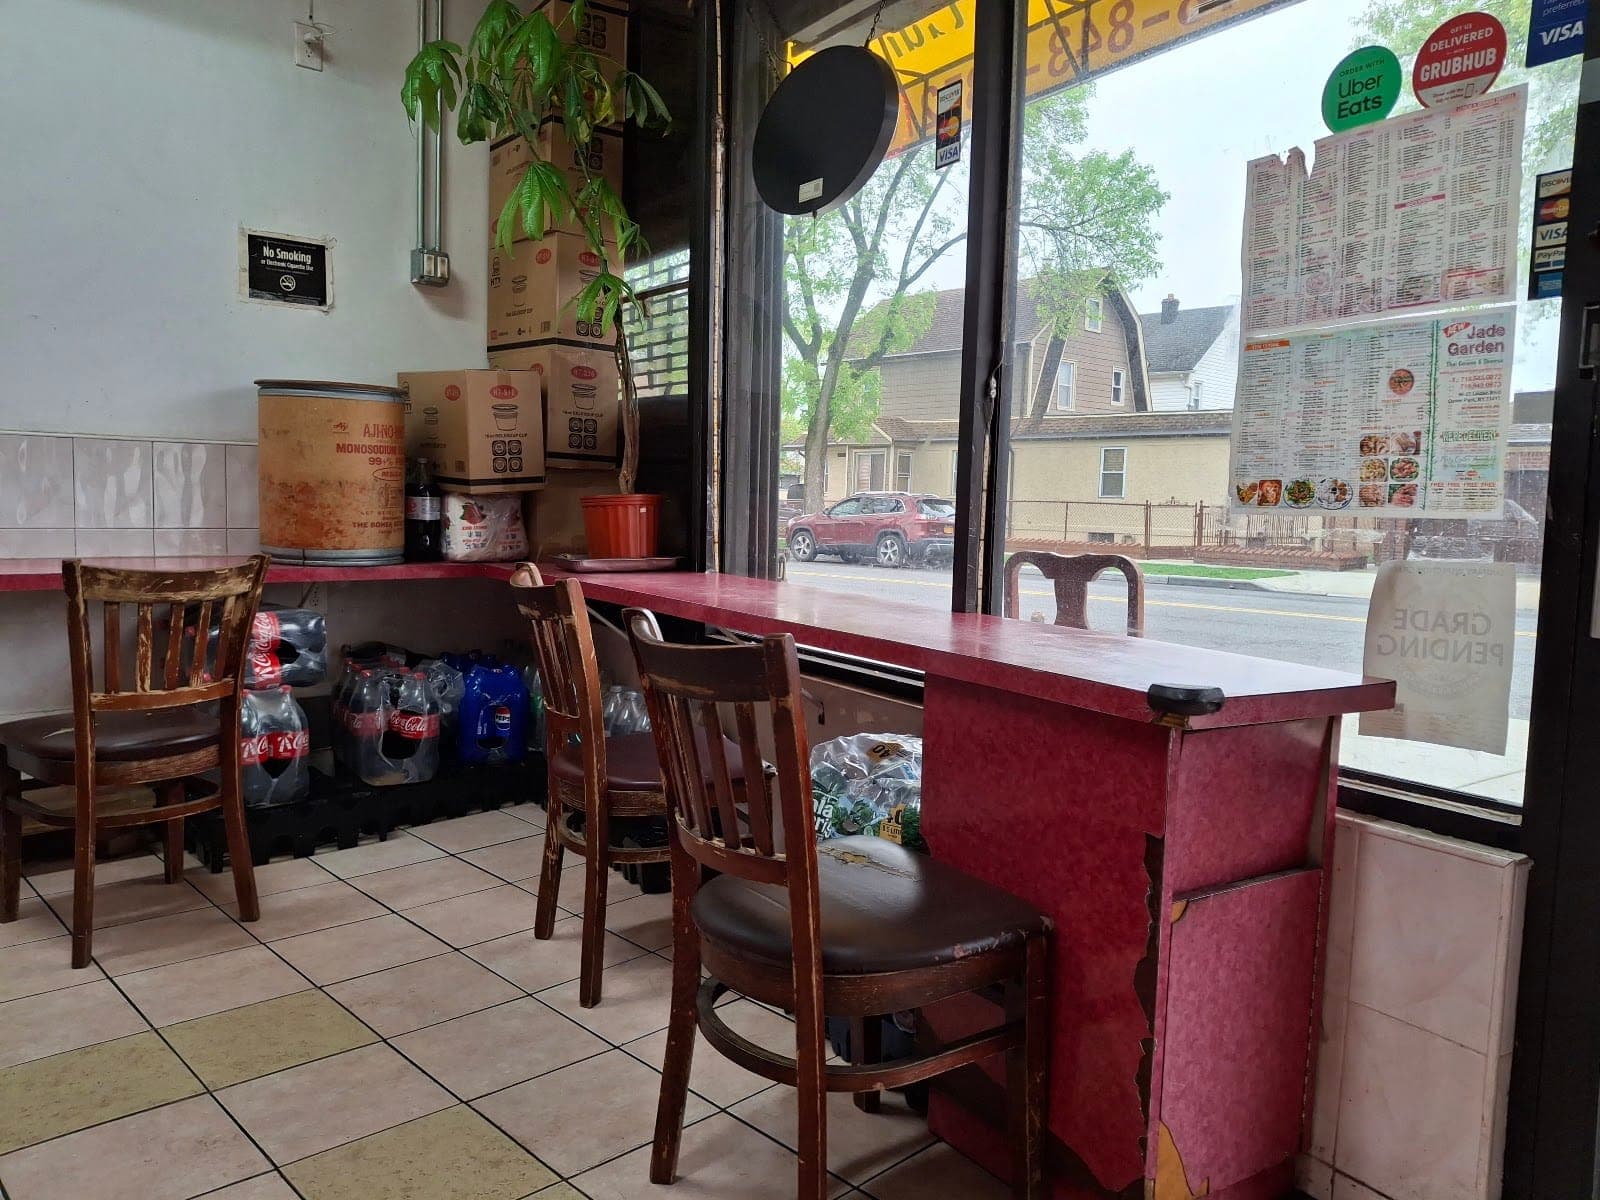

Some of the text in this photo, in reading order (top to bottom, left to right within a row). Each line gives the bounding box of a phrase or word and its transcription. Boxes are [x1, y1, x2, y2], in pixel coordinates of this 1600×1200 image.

[1431, 27, 1494, 52] DELIVERED
[1539, 21, 1584, 46] VISA
[1339, 59, 1385, 78] ORDER WITH
[1420, 47, 1497, 82] GRUBHUB
[1338, 74, 1384, 99] Uber
[1337, 95, 1383, 119] Eats
[939, 147, 958, 162] VISA
[263, 245, 312, 265] No Smoking
[1536, 250, 1565, 261] PayPa
[1467, 324, 1506, 339] Jade
[1447, 340, 1505, 356] Garden
[336, 443, 397, 455] MONOSODIUM
